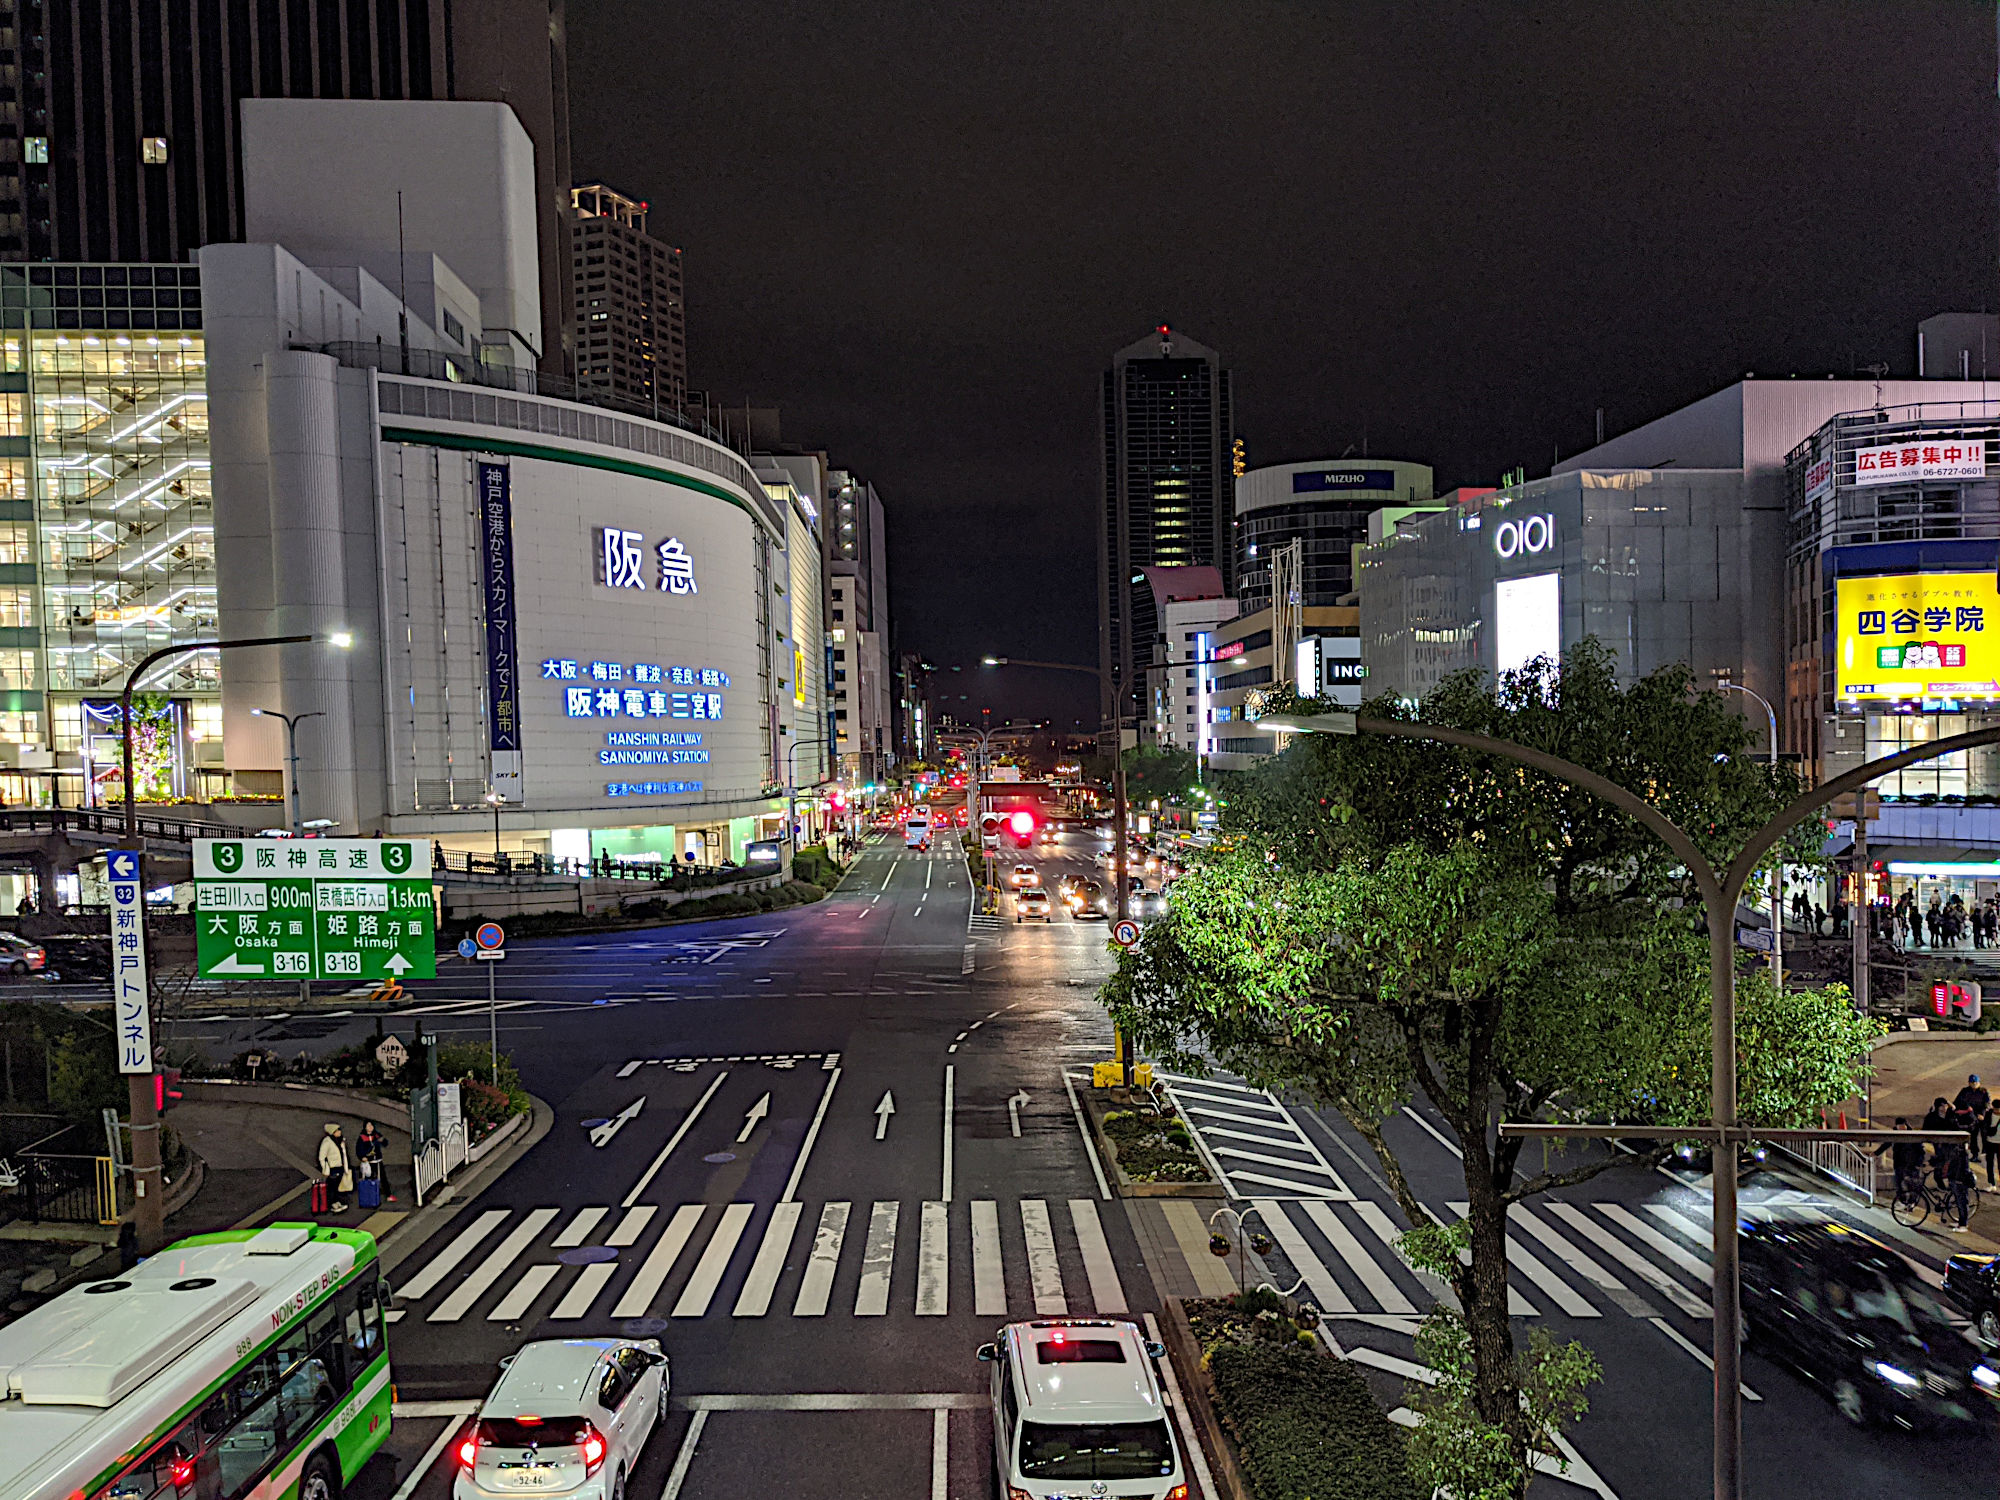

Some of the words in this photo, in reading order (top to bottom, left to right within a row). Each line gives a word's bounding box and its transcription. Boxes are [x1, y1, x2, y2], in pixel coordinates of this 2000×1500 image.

[1325, 474, 1365, 483] MIZUHO
[1923, 467, 1982, 476] 06-6727-0601
[603, 527, 698, 595] 阪急
[486, 468, 514, 746] 神戸空港からスカイマークで7都市へ
[1858, 606, 1984, 635] 四谷学院
[567, 688, 721, 720] 阪神電車三宮駅
[608, 732, 660, 746] HANSHIN
[662, 733, 702, 745] RAILWAY
[600, 750, 669, 764] SANNOMIYA
[672, 751, 709, 763] STATION
[220, 846, 235, 866] 3
[256, 848, 368, 869] 阪神高速
[389, 847, 404, 867] 3
[117, 888, 133, 900] 32
[200, 887, 264, 907] 生田川入口
[270, 886, 312, 908] 900m
[319, 887, 386, 907] 京橋西行入口
[208, 914, 303, 935] 大阪方面
[327, 914, 422, 936] 姫路方面
[234, 935, 279, 948] Osaka
[353, 936, 398, 950] Himeji
[276, 954, 307, 971] 3-16
[327, 954, 358, 971] 3-18
[116, 909, 145, 1066] 新神戸トンネル
[271, 1280, 319, 1330] NON-STEP
[321, 1264, 340, 1289] BUS
[236, 1337, 252, 1358] 988
[519, 1476, 543, 1485] 92-46
